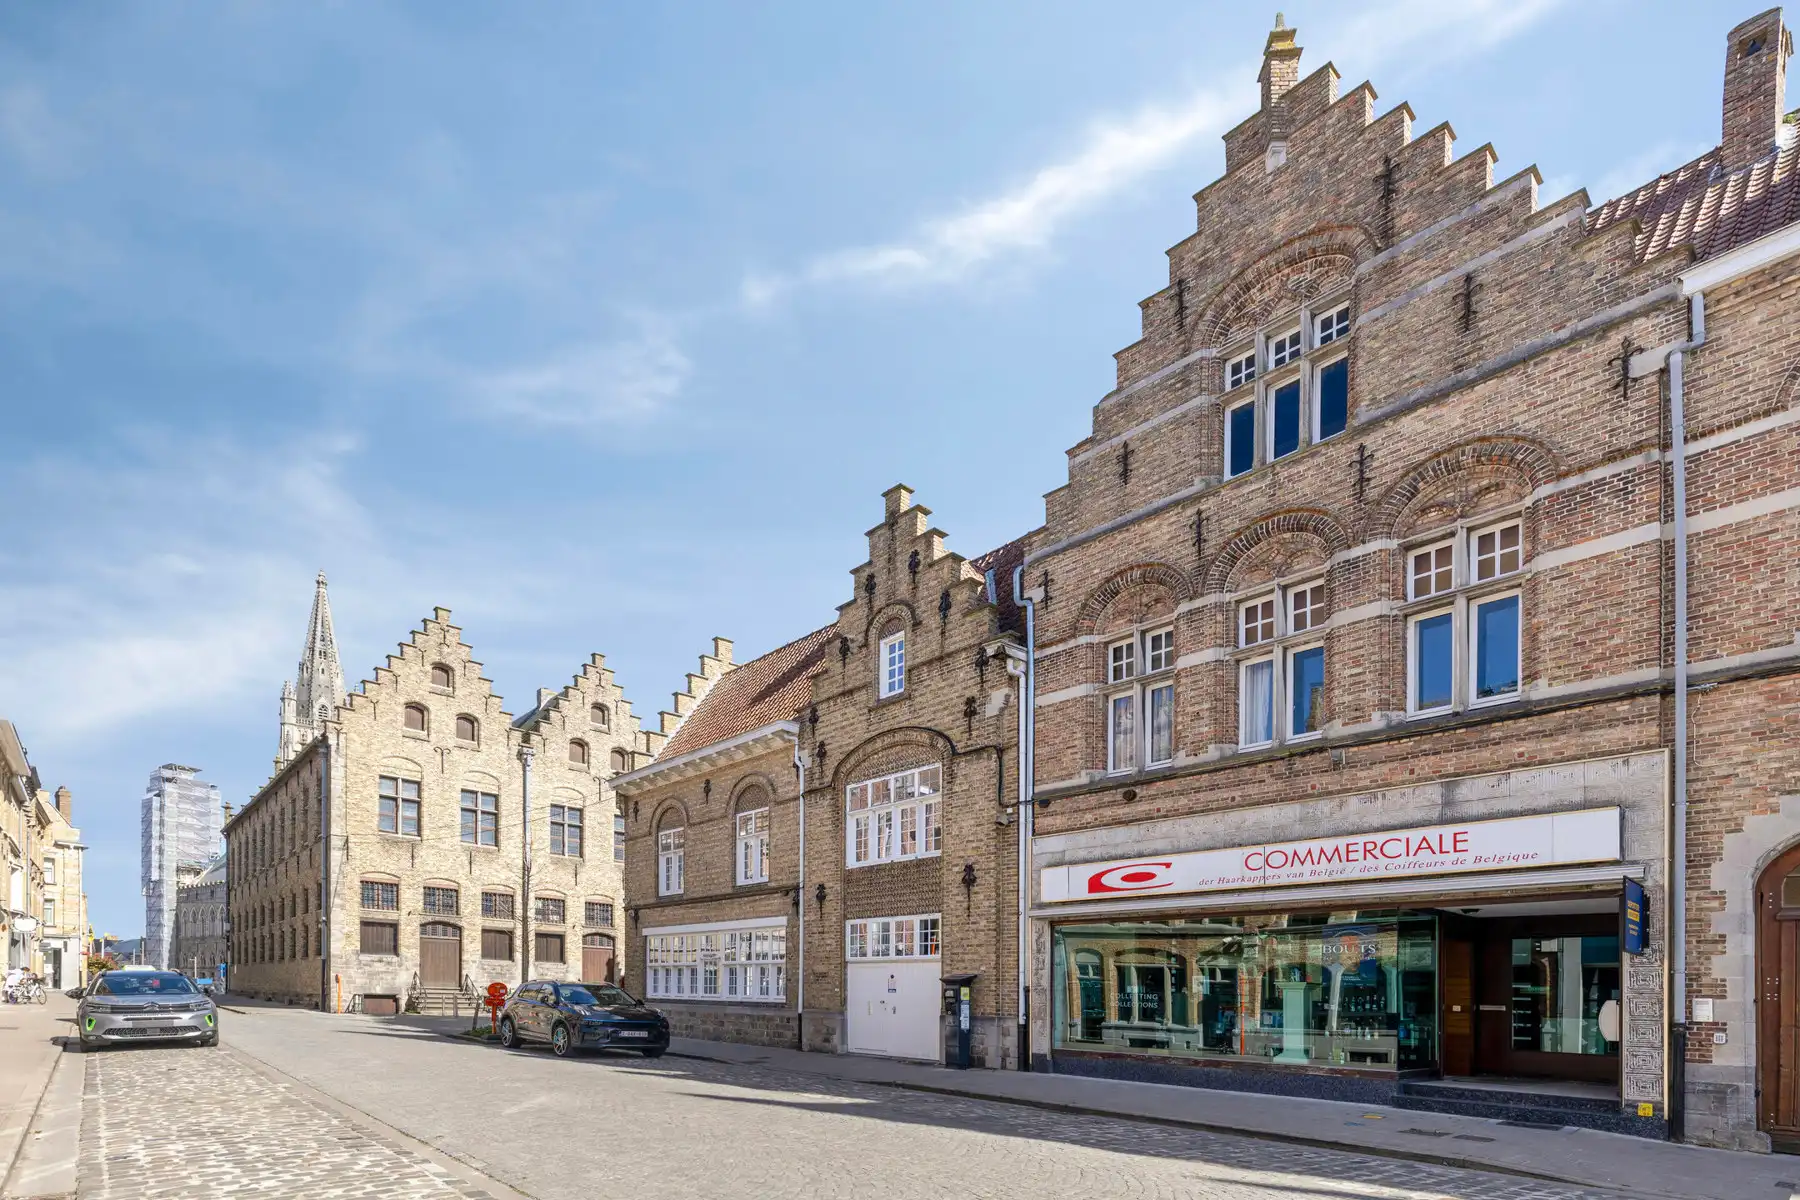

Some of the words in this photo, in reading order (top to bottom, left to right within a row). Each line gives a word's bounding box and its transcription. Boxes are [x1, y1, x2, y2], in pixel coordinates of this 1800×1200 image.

[1199, 878, 1215, 886] der
[1217, 873, 1282, 885] Haarkappers
[1286, 871, 1304, 879] van
[1309, 867, 1346, 878] België
[1359, 864, 1380, 874] des
[1384, 859, 1446, 871] Coiffeurs
[1451, 857, 1467, 866] de
[1473, 851, 1539, 865] Belgique
[1244, 831, 1469, 871] COMMERCIALE
